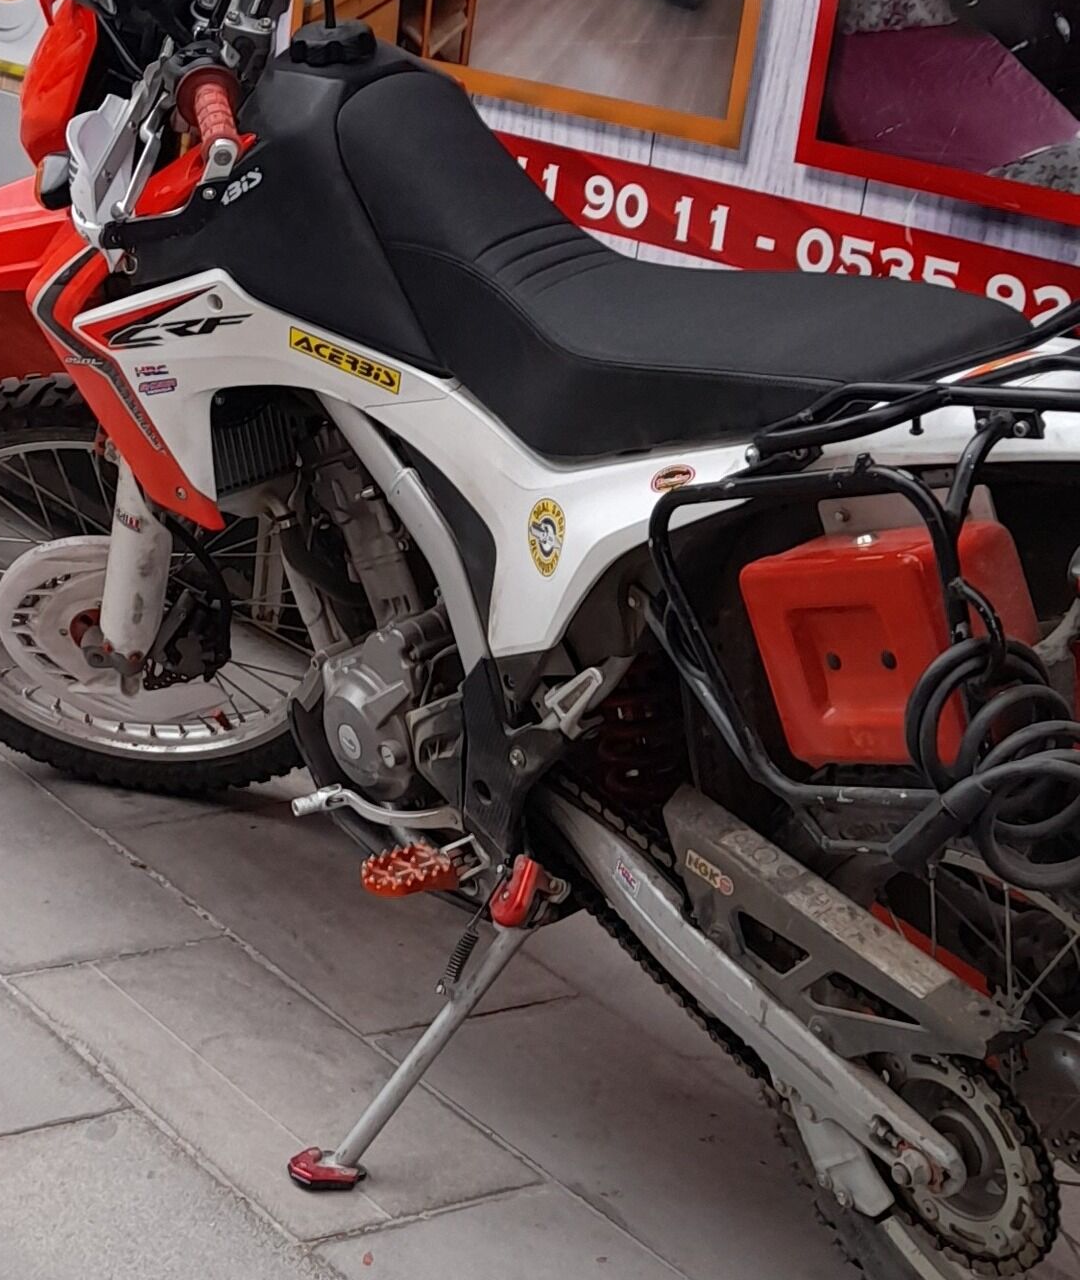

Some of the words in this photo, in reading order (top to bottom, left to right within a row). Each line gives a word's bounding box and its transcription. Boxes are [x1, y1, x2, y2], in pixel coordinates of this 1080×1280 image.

[581, 175, 649, 229] 90
[674, 196, 730, 252] 11
[110, 313, 254, 347] CRF
[294, 336, 396, 387] ACERBIS
[688, 853, 719, 887] NGK
